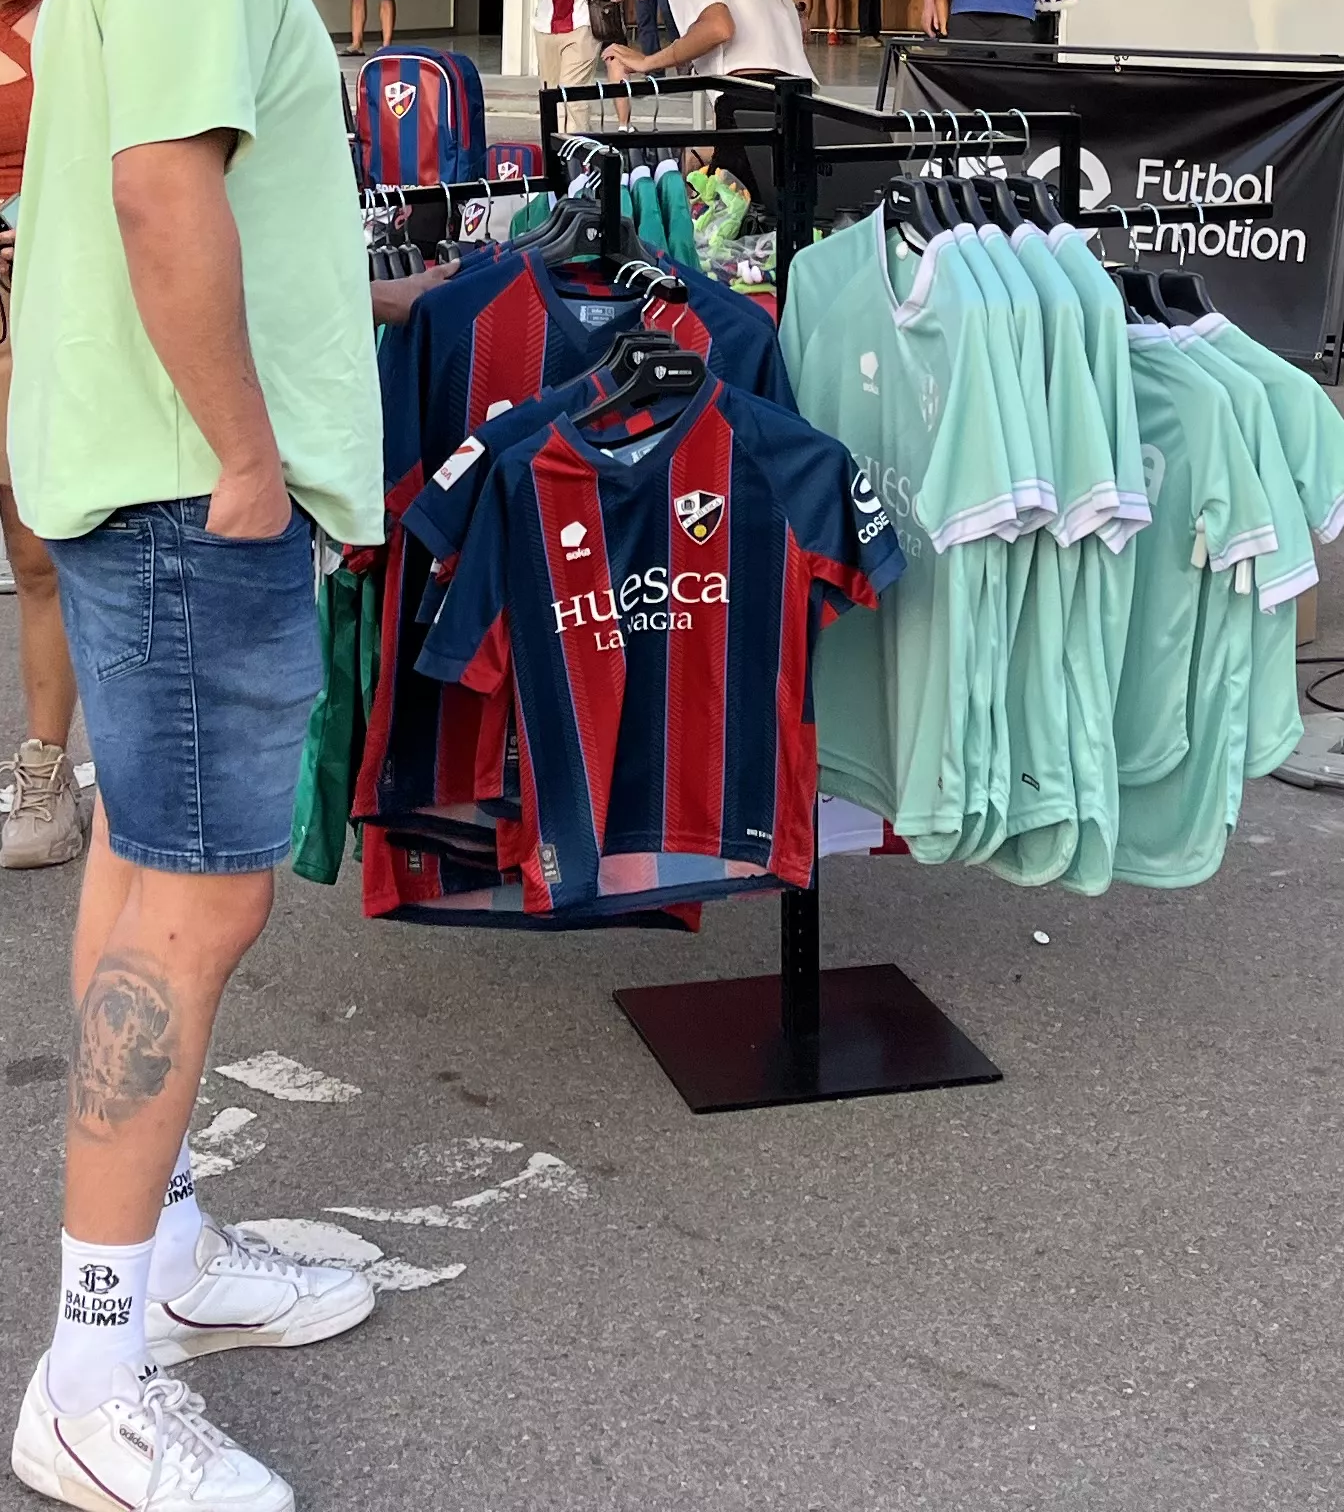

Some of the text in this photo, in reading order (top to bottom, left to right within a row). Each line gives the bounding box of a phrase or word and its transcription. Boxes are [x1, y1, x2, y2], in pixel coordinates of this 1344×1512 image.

[1136, 158, 1274, 204] Fútbol
[65, 1289, 133, 1312] BALDOVI
[64, 1303, 131, 1327] DRUMS
[119, 1427, 149, 1452] adidas
